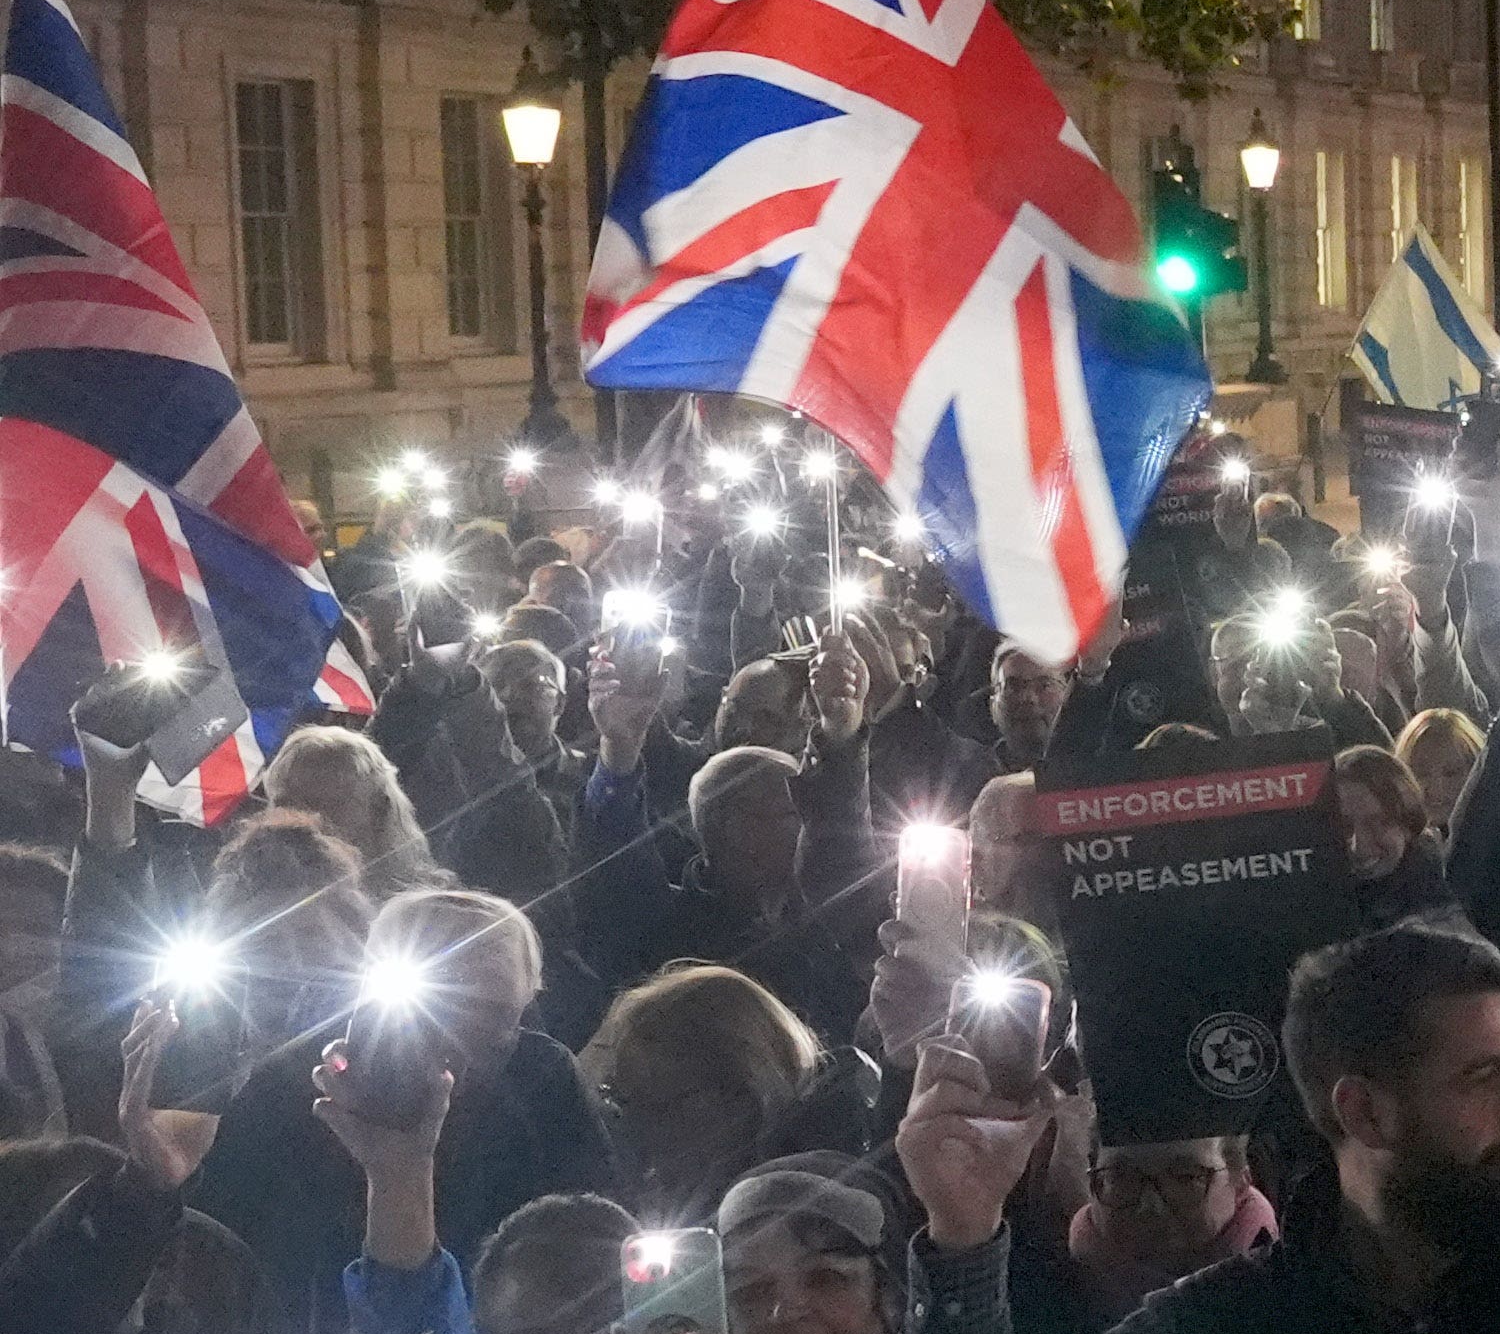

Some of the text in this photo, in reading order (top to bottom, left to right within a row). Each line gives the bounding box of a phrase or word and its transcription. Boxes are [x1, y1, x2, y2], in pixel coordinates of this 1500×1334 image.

[1057, 772, 1307, 824] ENFORCEMENT
[1062, 835, 1134, 866] NOT
[1071, 848, 1314, 900] APPEASEMENT
